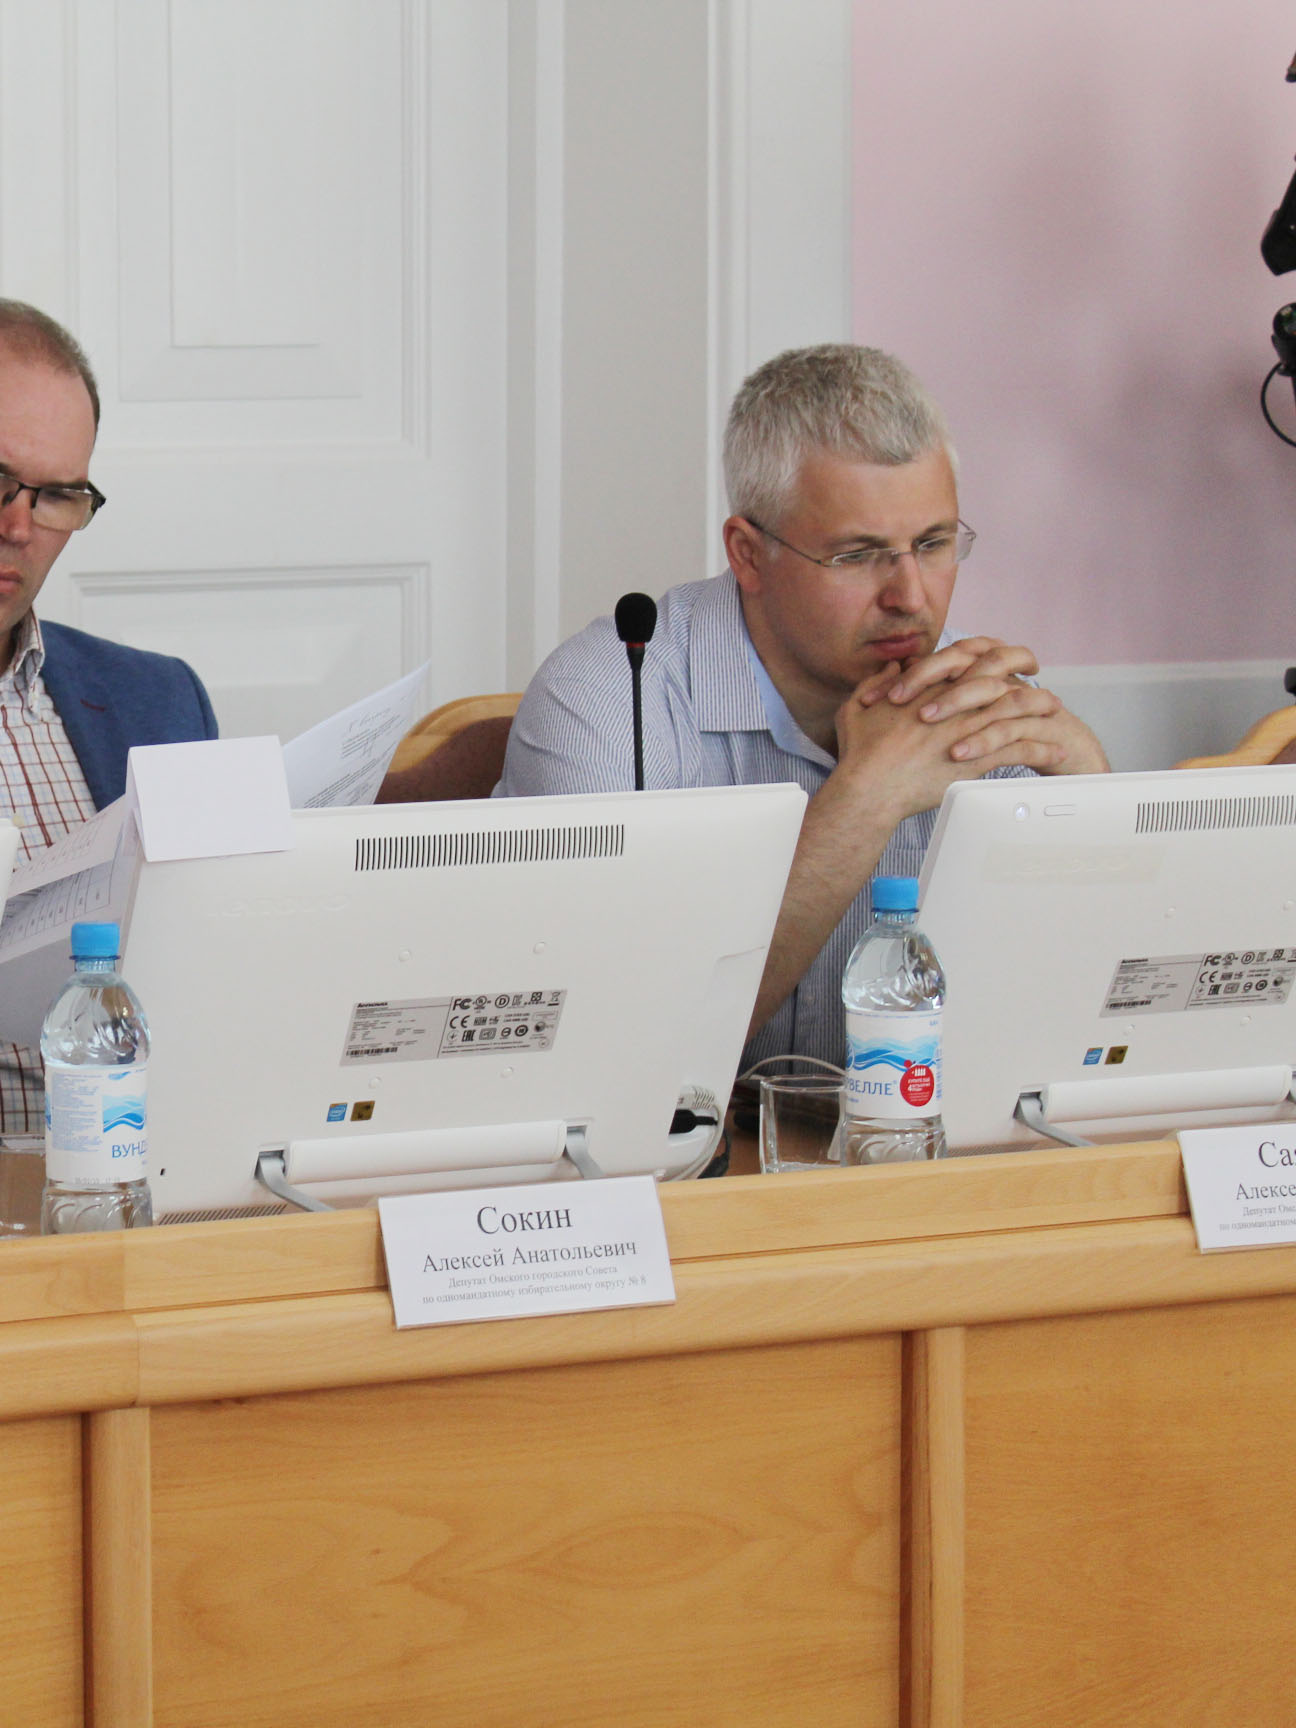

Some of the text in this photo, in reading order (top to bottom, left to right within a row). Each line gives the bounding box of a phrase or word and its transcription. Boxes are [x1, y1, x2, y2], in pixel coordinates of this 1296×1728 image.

[1258, 1141, 1296, 1168] Са
[1236, 1183, 1296, 1200] Алексе
[476, 1205, 573, 1235] Сокин
[1243, 1206, 1277, 1218] Депутат
[422, 1241, 639, 1273] Алексей Анатольевич
[448, 1264, 618, 1289] Депутат Омского городского Совета
[422, 1295, 435, 1305] по
[436, 1286, 516, 1304] одномандатному
[518, 1280, 593, 1296] избирательному
[594, 1276, 627, 1289] округу
